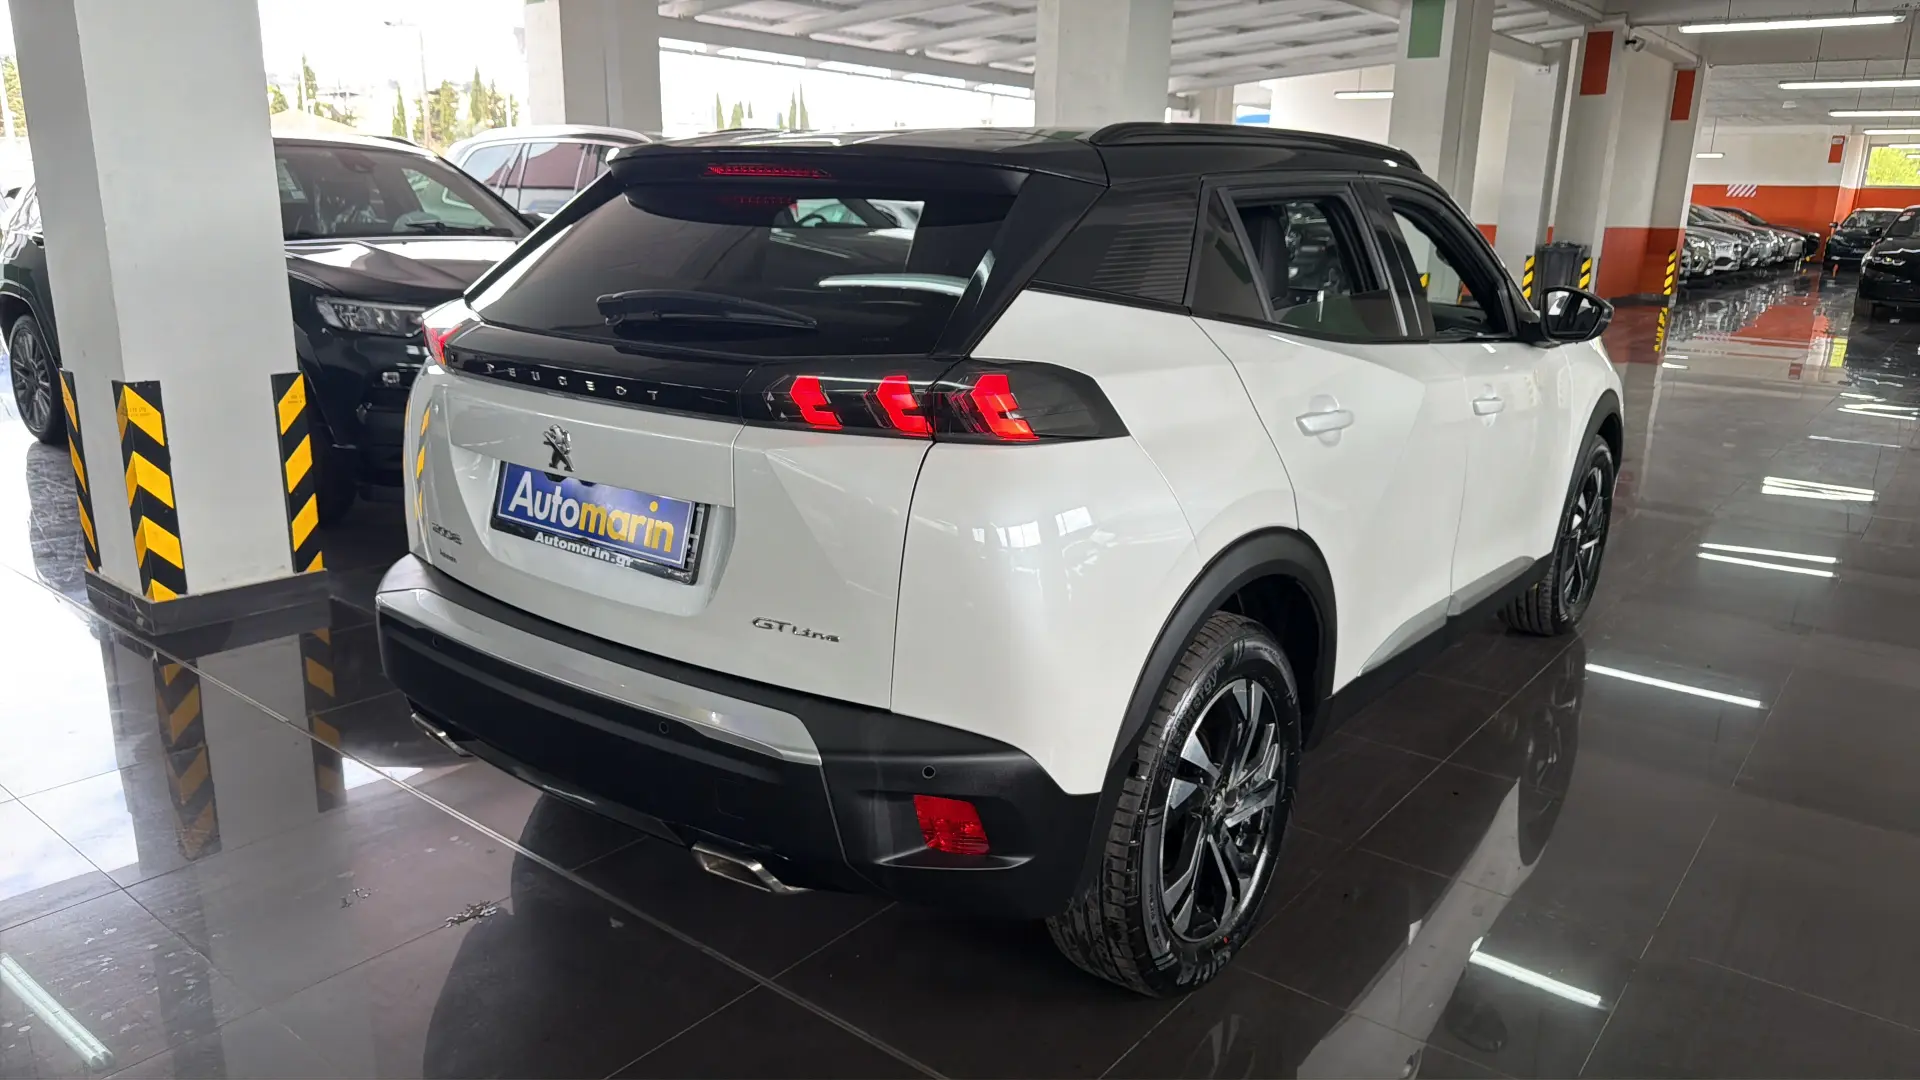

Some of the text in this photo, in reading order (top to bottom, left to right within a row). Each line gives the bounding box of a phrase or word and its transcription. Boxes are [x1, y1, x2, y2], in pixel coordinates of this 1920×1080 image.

[486, 362, 659, 401] PEUGEOT
[507, 470, 675, 553] Automarin
[534, 531, 634, 569] Automarin.gr
[752, 616, 792, 633] GT
